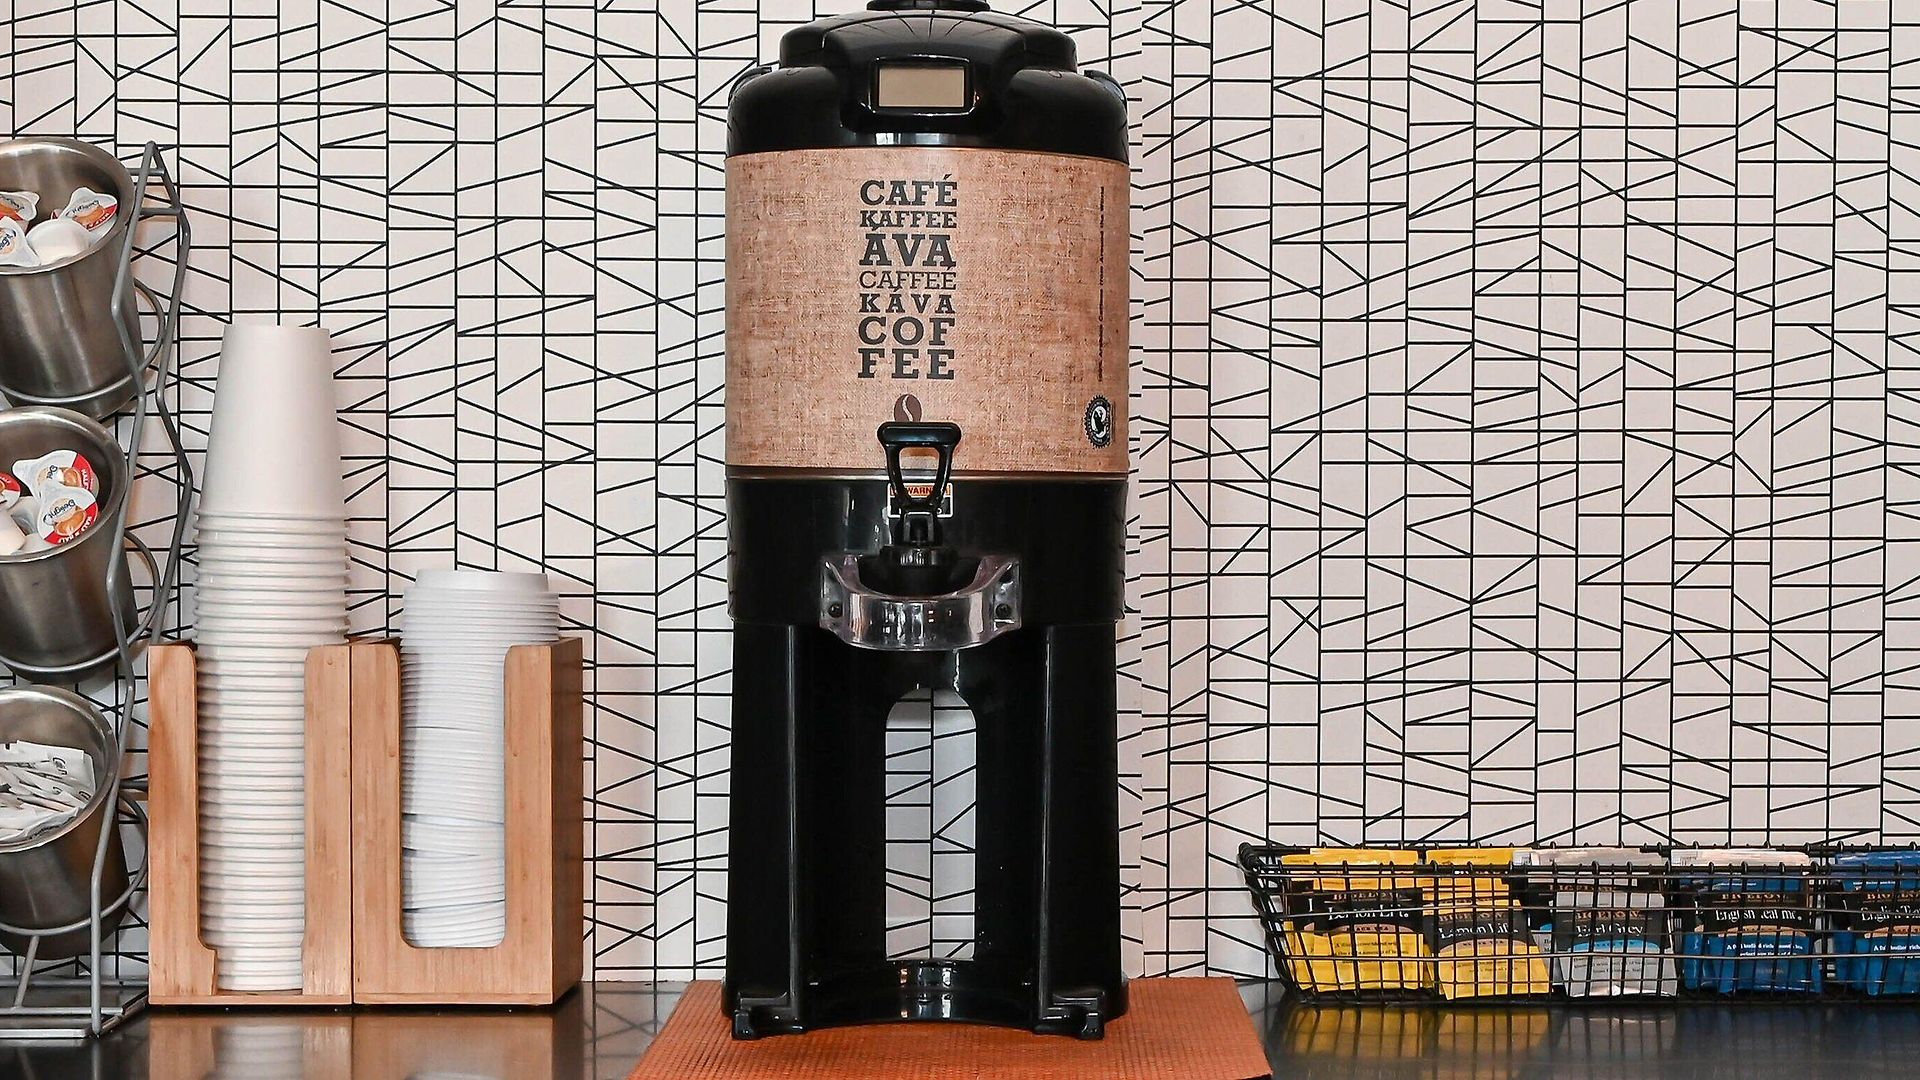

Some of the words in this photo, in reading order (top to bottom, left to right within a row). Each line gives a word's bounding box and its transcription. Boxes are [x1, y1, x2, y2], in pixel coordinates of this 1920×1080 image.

[859, 173, 958, 207] CAFÉ
[859, 210, 958, 229] KAFFEE
[857, 315, 956, 346] COF
[857, 347, 955, 380] FEE
[1716, 908, 1756, 923] Englsh
